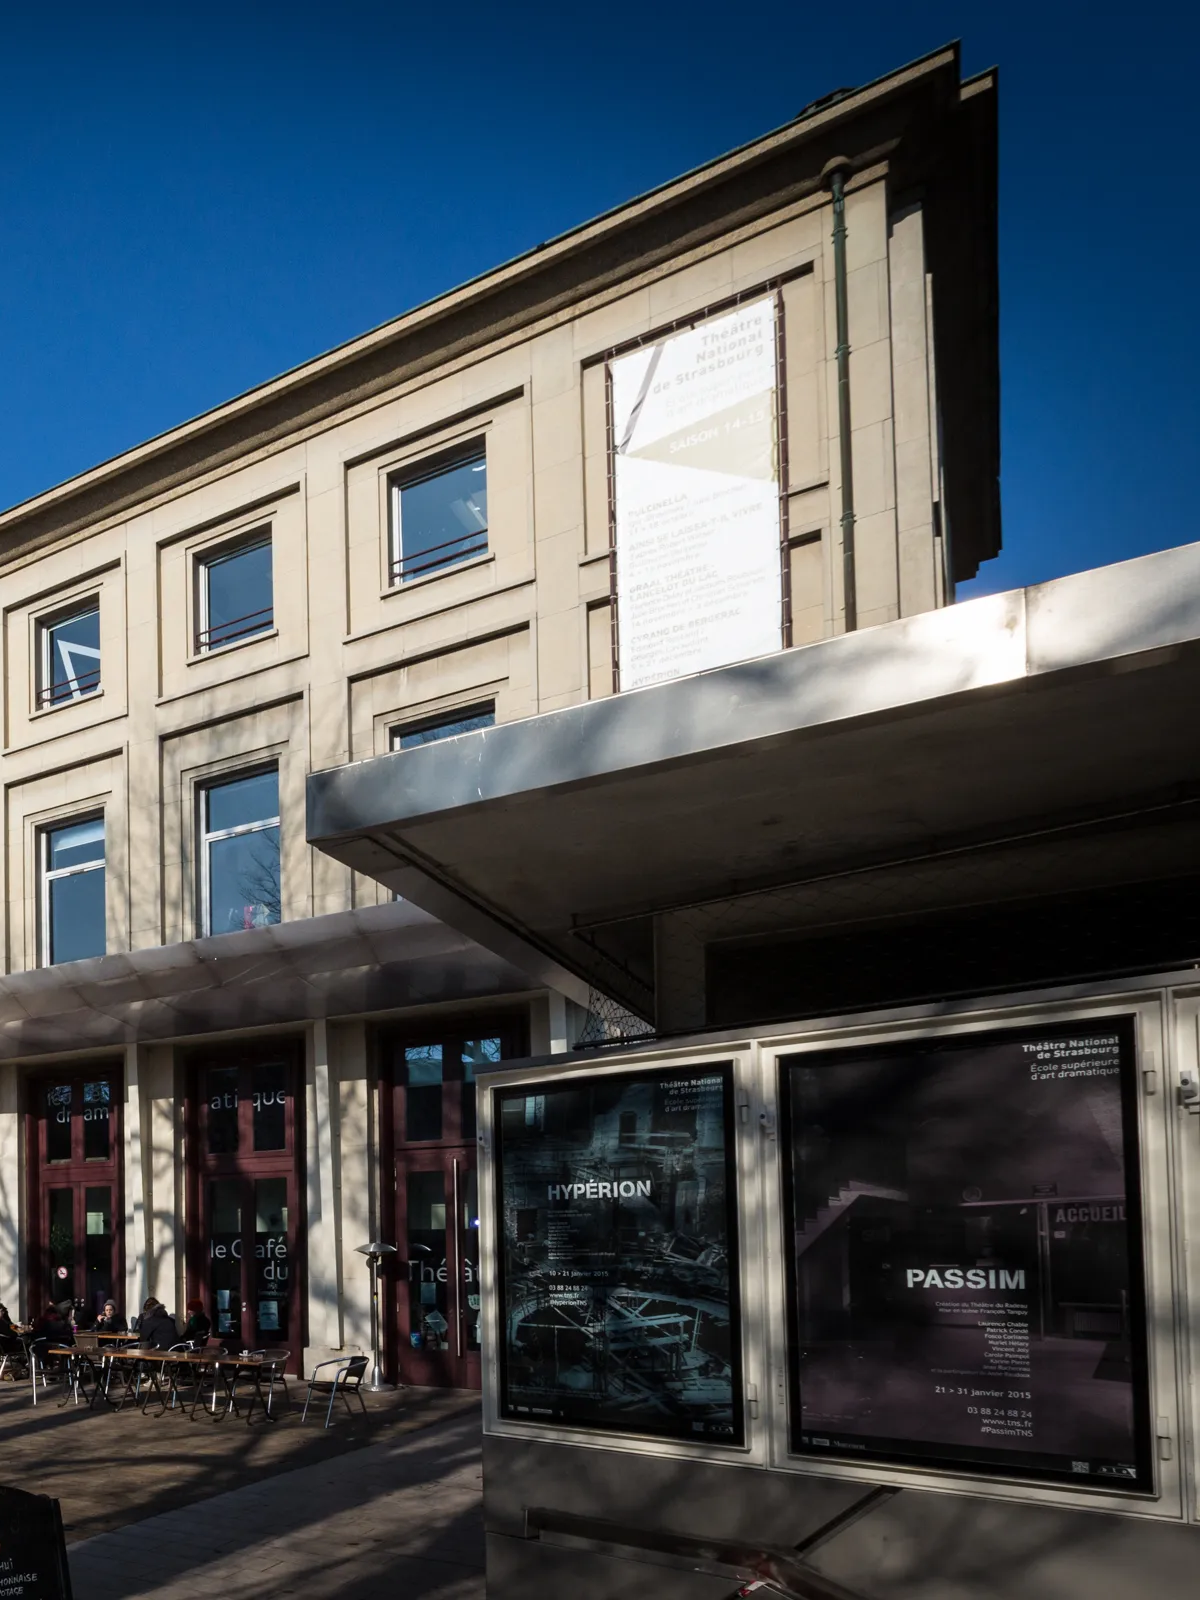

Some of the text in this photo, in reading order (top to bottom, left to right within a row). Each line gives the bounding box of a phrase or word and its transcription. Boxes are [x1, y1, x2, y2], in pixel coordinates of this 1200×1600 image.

[701, 315, 762, 347] Théâtre
[696, 330, 763, 364] National
[653, 380, 671, 395] de
[674, 343, 764, 386] Strasbourg
[669, 409, 765, 454] SAISON 14-15
[628, 492, 688, 517] PULCINELLA
[628, 536, 655, 552] AINSI
[656, 532, 669, 544] SE
[731, 501, 763, 518] VIVRE
[629, 569, 719, 602] LANCELOT DU LAC
[629, 579, 662, 594] GRAAL
[630, 607, 741, 645] CYRANO DE BERGERAC
[1022, 1036, 1119, 1052] Théâtre National
[1053, 1046, 1119, 1058] Strasbourg
[1030, 1058, 1120, 1072] École supérieure
[1031, 1067, 1120, 1080] d'art dramatique
[660, 1076, 723, 1089] Théâtre National
[548, 1179, 651, 1200] HYPÉRION
[1055, 1206, 1127, 1222] ACCUEIL
[210, 1236, 287, 1258] le Café
[263, 1260, 289, 1280] du
[570, 1270, 592, 1278] janvier
[906, 1269, 1026, 1289] PASSIM
[970, 1389, 1004, 1397] janvier
[1007, 1390, 1031, 1399] 2015
[967, 1406, 1032, 1418] 03 88 24 88 24
[980, 1426, 1033, 1437] #PassimTNS
[981, 1418, 1032, 1428] www.tns.fr
